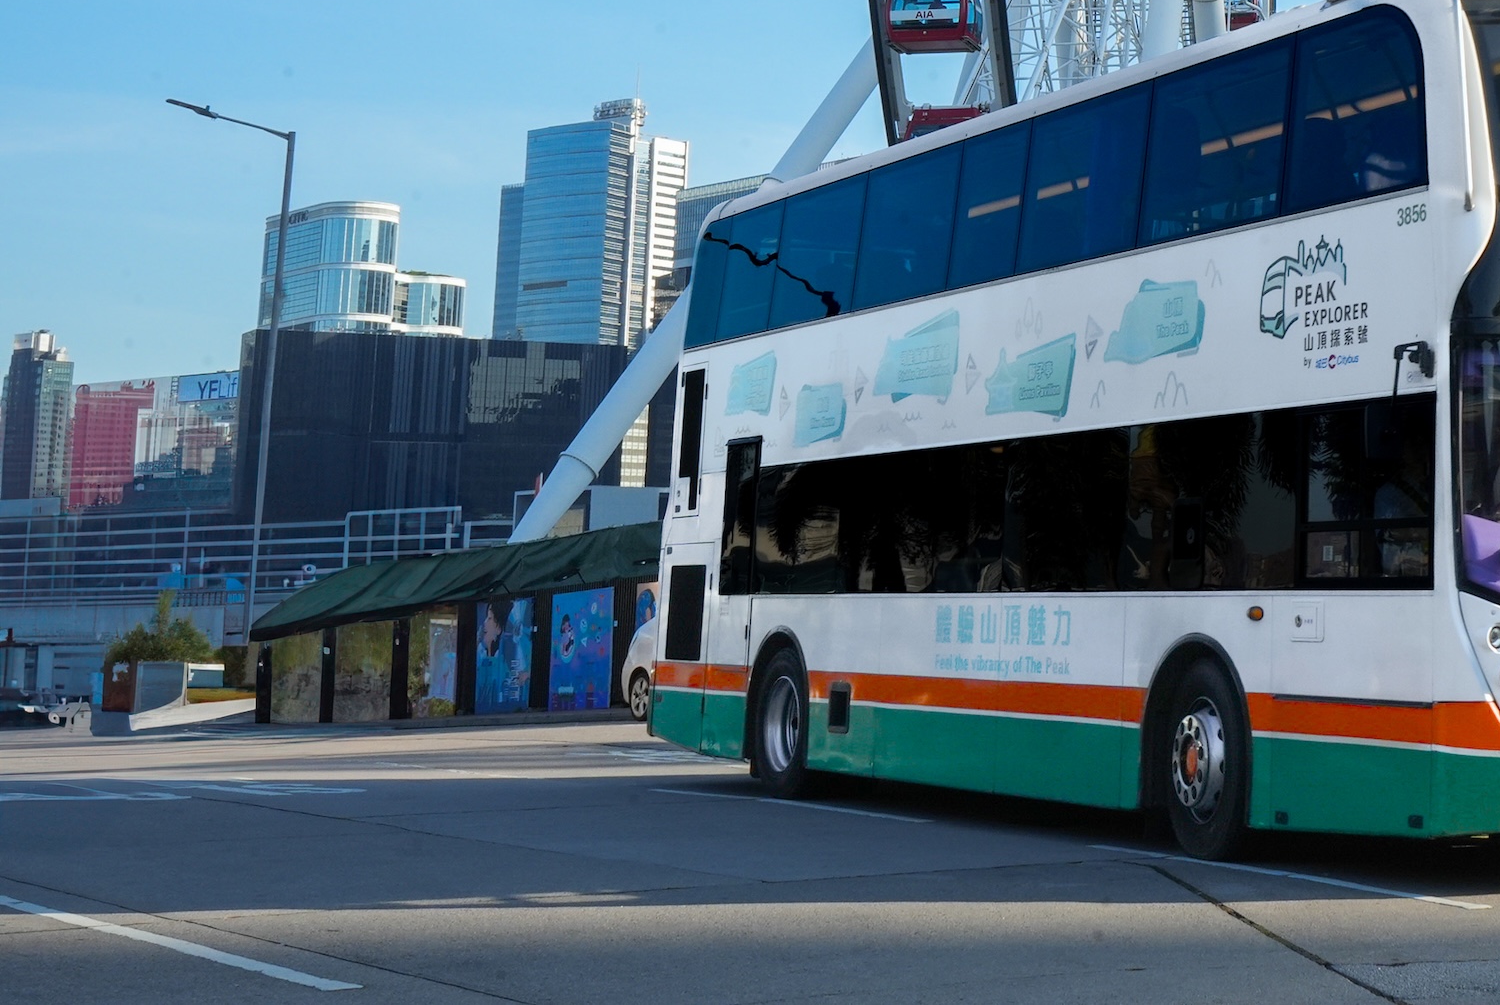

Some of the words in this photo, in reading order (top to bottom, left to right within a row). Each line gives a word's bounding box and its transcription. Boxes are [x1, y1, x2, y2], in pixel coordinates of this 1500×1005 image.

[915, 11, 934, 19] AIA
[1397, 203, 1427, 227] 3856
[1294, 280, 1337, 308] PEAK
[1304, 302, 1369, 328] EXPLORER
[1304, 325, 1369, 351] 山頂探索號
[1303, 357, 1312, 369] by
[934, 654, 953, 670] Feel
[954, 654, 969, 672] the
[971, 655, 1010, 677] vibrancy
[1013, 656, 1024, 673] of
[1025, 656, 1042, 674] The
[1045, 657, 1071, 675] Peak
